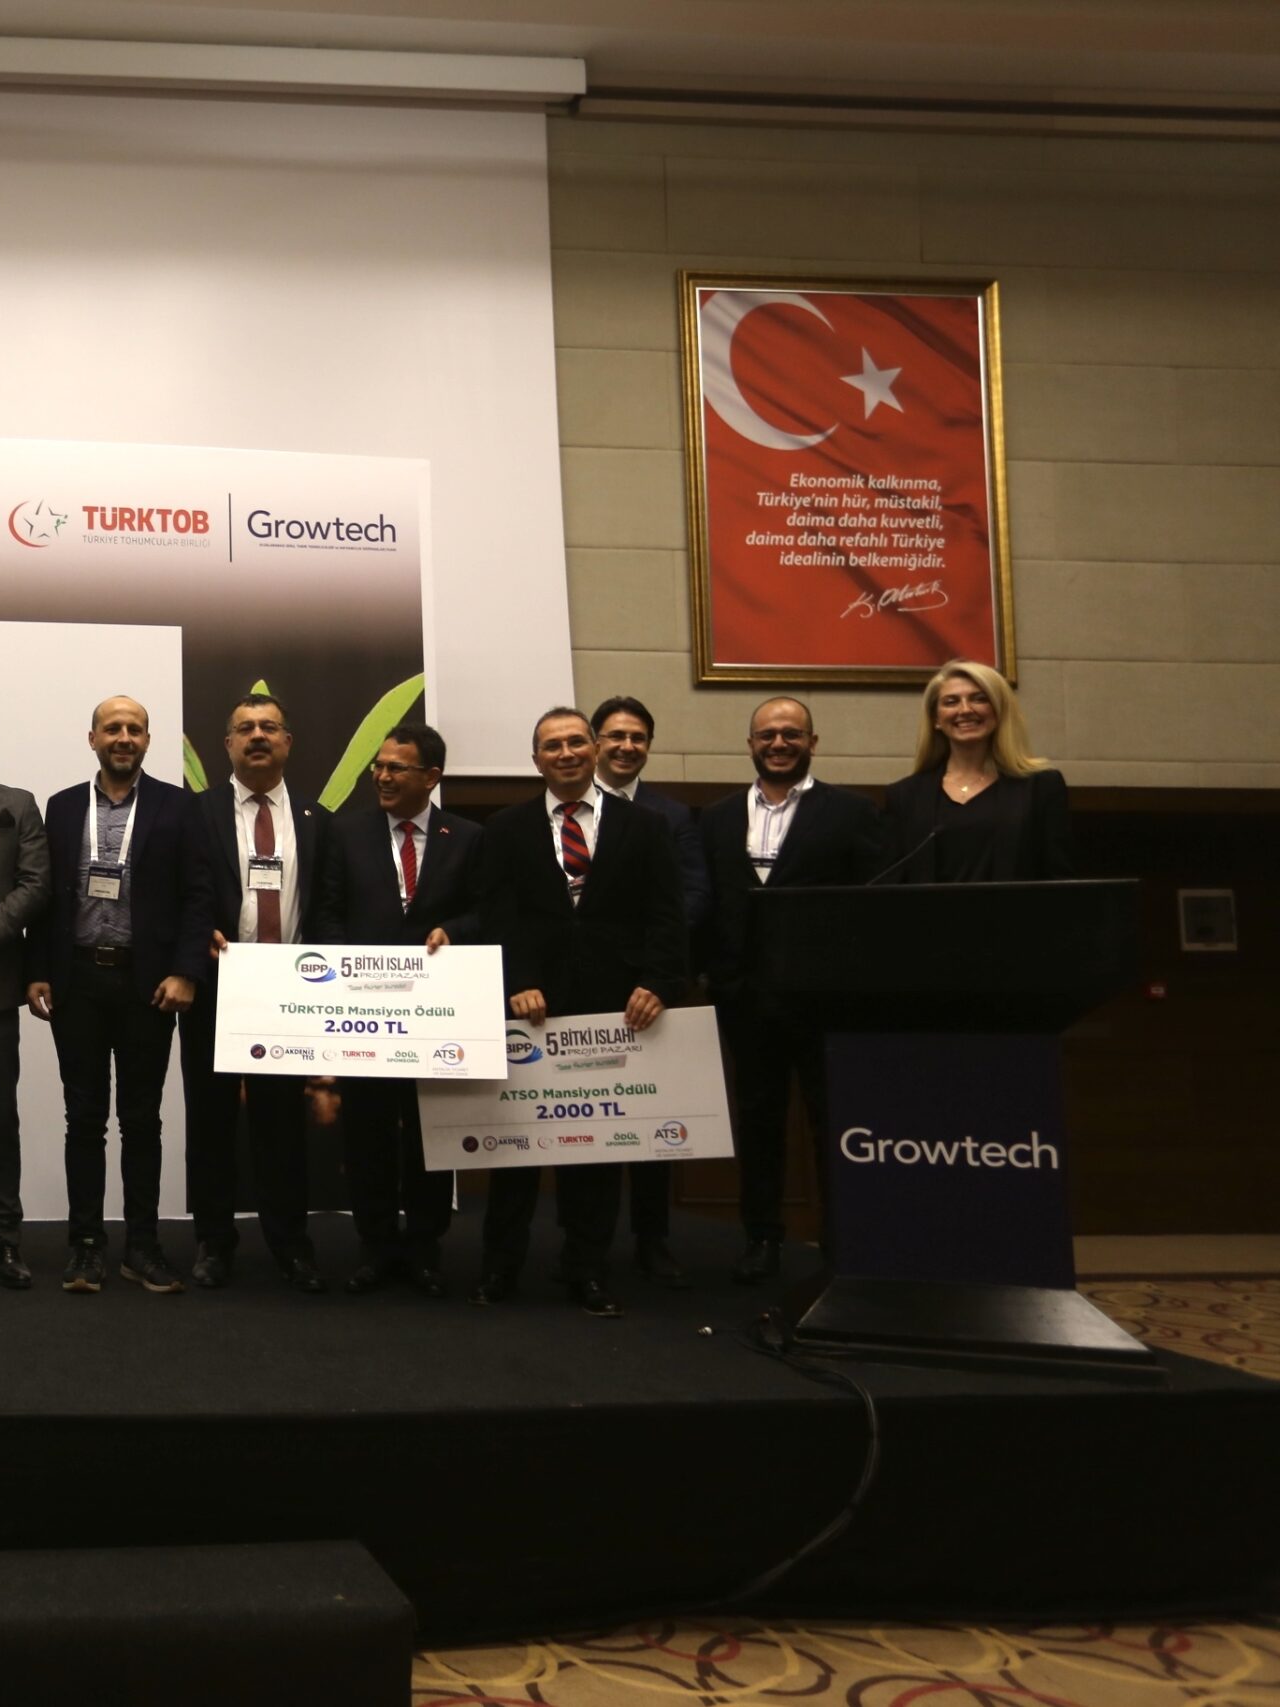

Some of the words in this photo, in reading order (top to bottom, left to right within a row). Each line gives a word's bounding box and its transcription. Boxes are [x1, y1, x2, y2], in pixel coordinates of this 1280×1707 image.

[789, 473, 865, 489] Ekonomik
[868, 474, 942, 491] kalkınma,
[842, 494, 871, 509] hür,
[874, 495, 943, 511] müstakil,
[82, 506, 210, 534] TÜRKTOB
[247, 510, 397, 543] Growtech
[786, 512, 836, 528] daima
[838, 513, 878, 528] daha
[880, 514, 944, 531] kuvvetli,
[745, 530, 795, 546] daima
[797, 531, 837, 547] daha
[839, 532, 888, 548] refahlı
[891, 534, 945, 552] Türkiye
[779, 552, 845, 567] idealinin
[849, 552, 946, 571] belkemiğidir.
[301, 964, 328, 973] BIPP
[341, 957, 358, 978] 5.
[355, 955, 384, 970] BİTKİ
[387, 957, 423, 972] ISLAHI
[280, 1002, 344, 1015] TÜRKTOB
[348, 1006, 411, 1018] Mansiyon
[415, 1005, 455, 1017] Ödülü
[324, 1020, 379, 1033] 2.000
[384, 1021, 408, 1034] TL
[545, 1032, 566, 1056] 5.
[560, 1027, 592, 1047] BİTKİ
[499, 1089, 539, 1101] ATSO
[543, 1086, 610, 1101] Mansiyon
[613, 1083, 657, 1096] Ödülü
[536, 1103, 594, 1120] 2.000
[599, 1102, 626, 1117] TL
[840, 1127, 1058, 1169] Growtech
